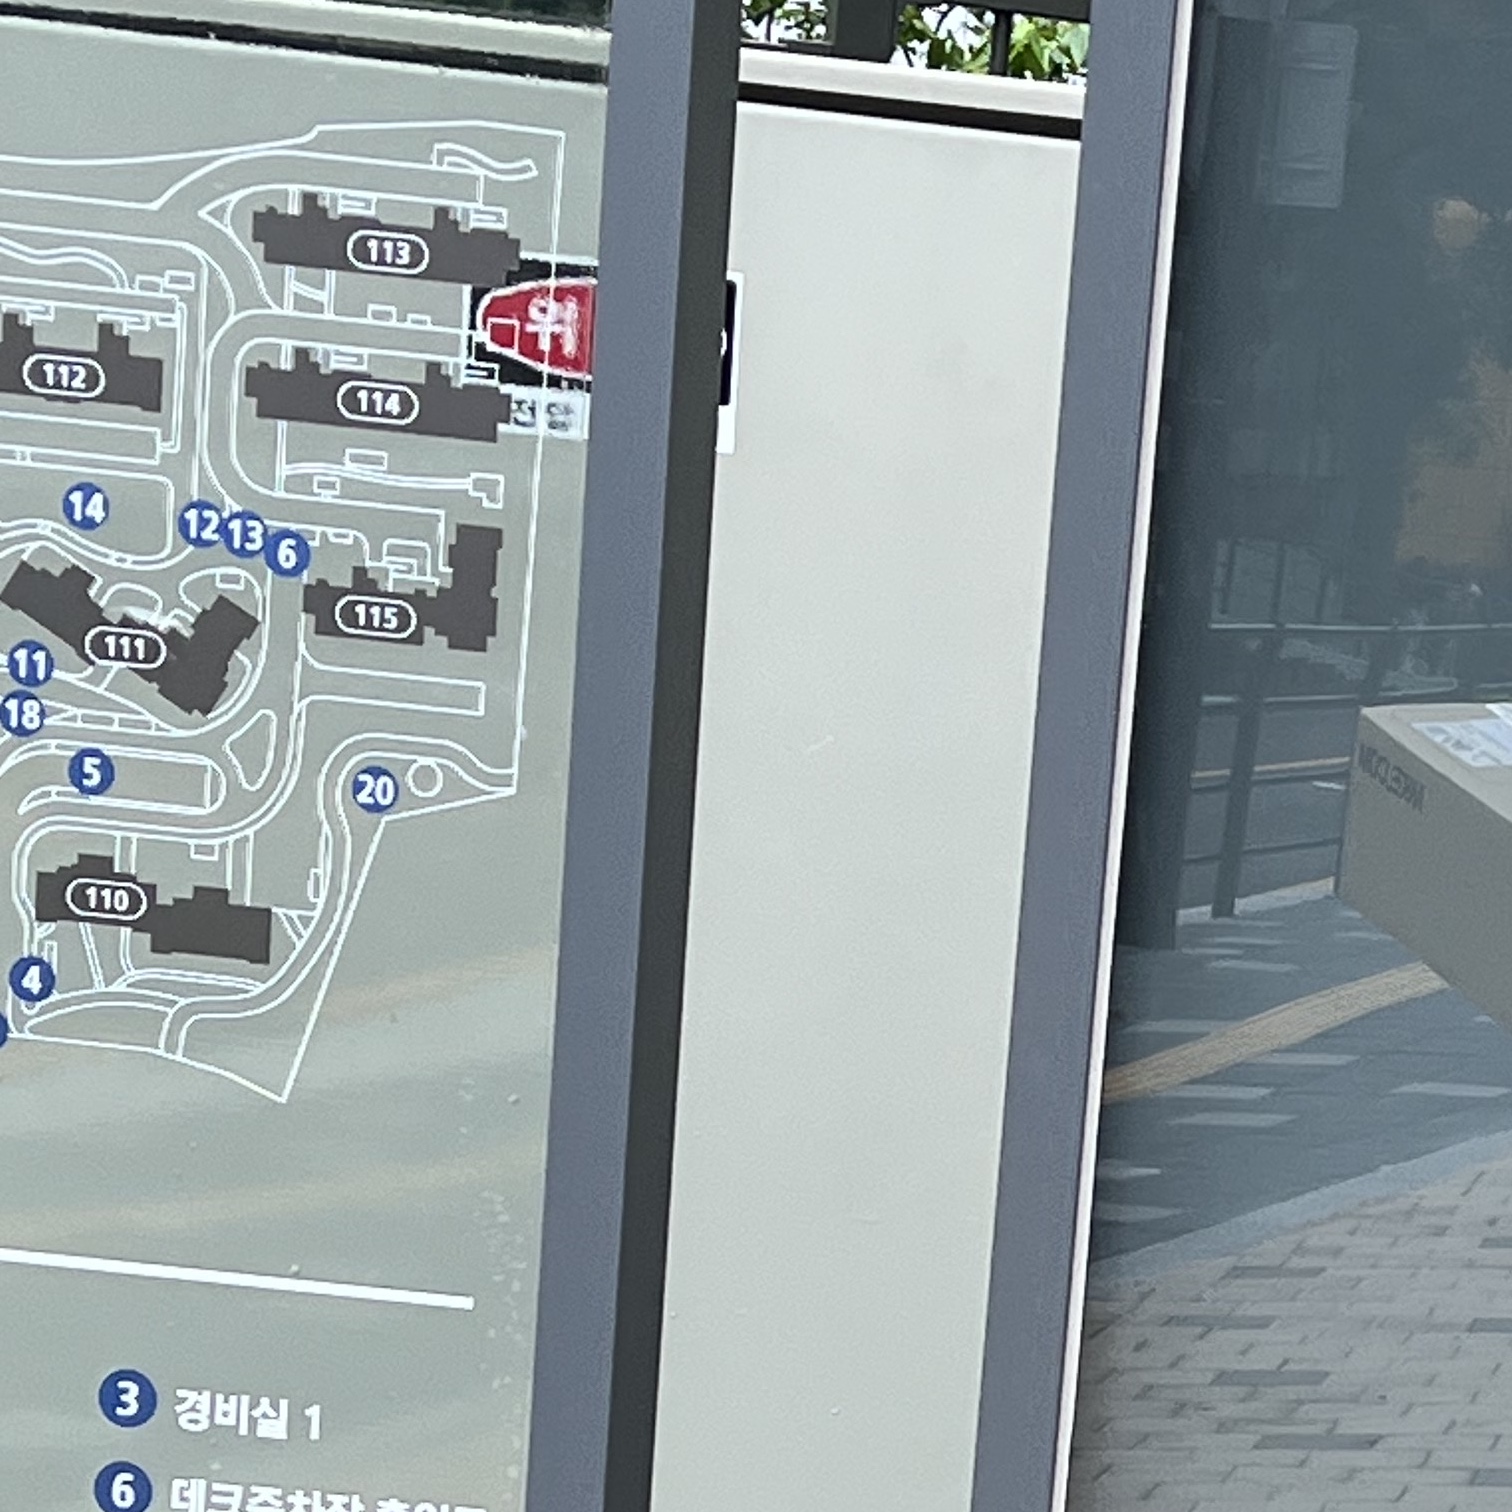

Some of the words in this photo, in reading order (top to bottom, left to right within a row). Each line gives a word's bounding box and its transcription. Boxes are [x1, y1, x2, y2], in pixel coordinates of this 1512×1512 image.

[366, 238, 411, 266] 113
[42, 363, 87, 388] 112
[356, 389, 402, 416] 114
[69, 491, 106, 523] 14
[184, 508, 219, 541] 12
[228, 518, 263, 551] 13
[278, 538, 297, 569] 6
[354, 604, 400, 630] 115
[104, 635, 147, 660] 111
[14, 648, 46, 680] 11
[5, 697, 41, 730] 18
[81, 757, 102, 787] 5
[356, 774, 394, 805] 20
[85, 887, 130, 912] 110
[21, 965, 42, 995] 4
[116, 1381, 139, 1416] 3
[174, 1389, 289, 1440] 경비실
[304, 1404, 321, 1441] 1
[112, 1472, 135, 1508] 6
